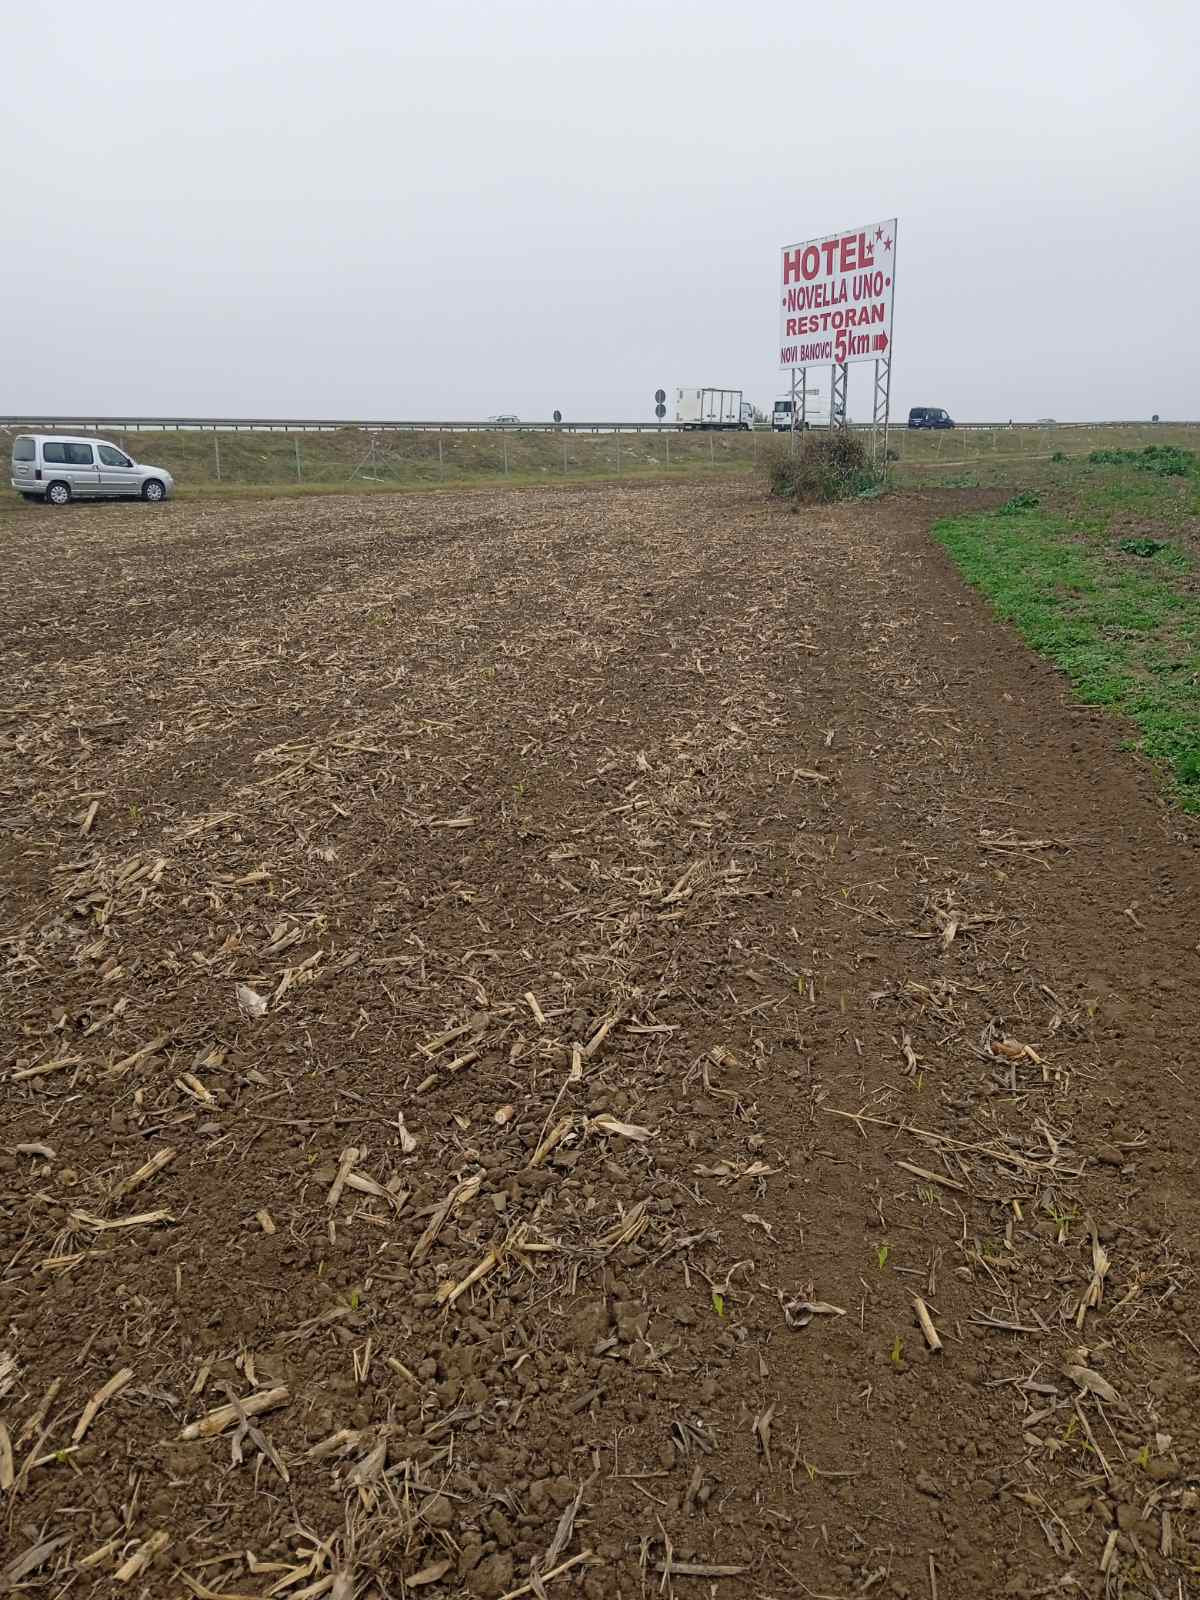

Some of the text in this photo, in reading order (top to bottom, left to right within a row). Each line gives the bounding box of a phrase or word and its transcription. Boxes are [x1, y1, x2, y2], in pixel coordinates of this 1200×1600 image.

[784, 232, 874, 285] HOTEL
[787, 271, 884, 312] NOVELLA UNO
[786, 303, 885, 337] RESTORAN
[780, 345, 798, 364] NOVI
[800, 341, 832, 362] BANOVCI
